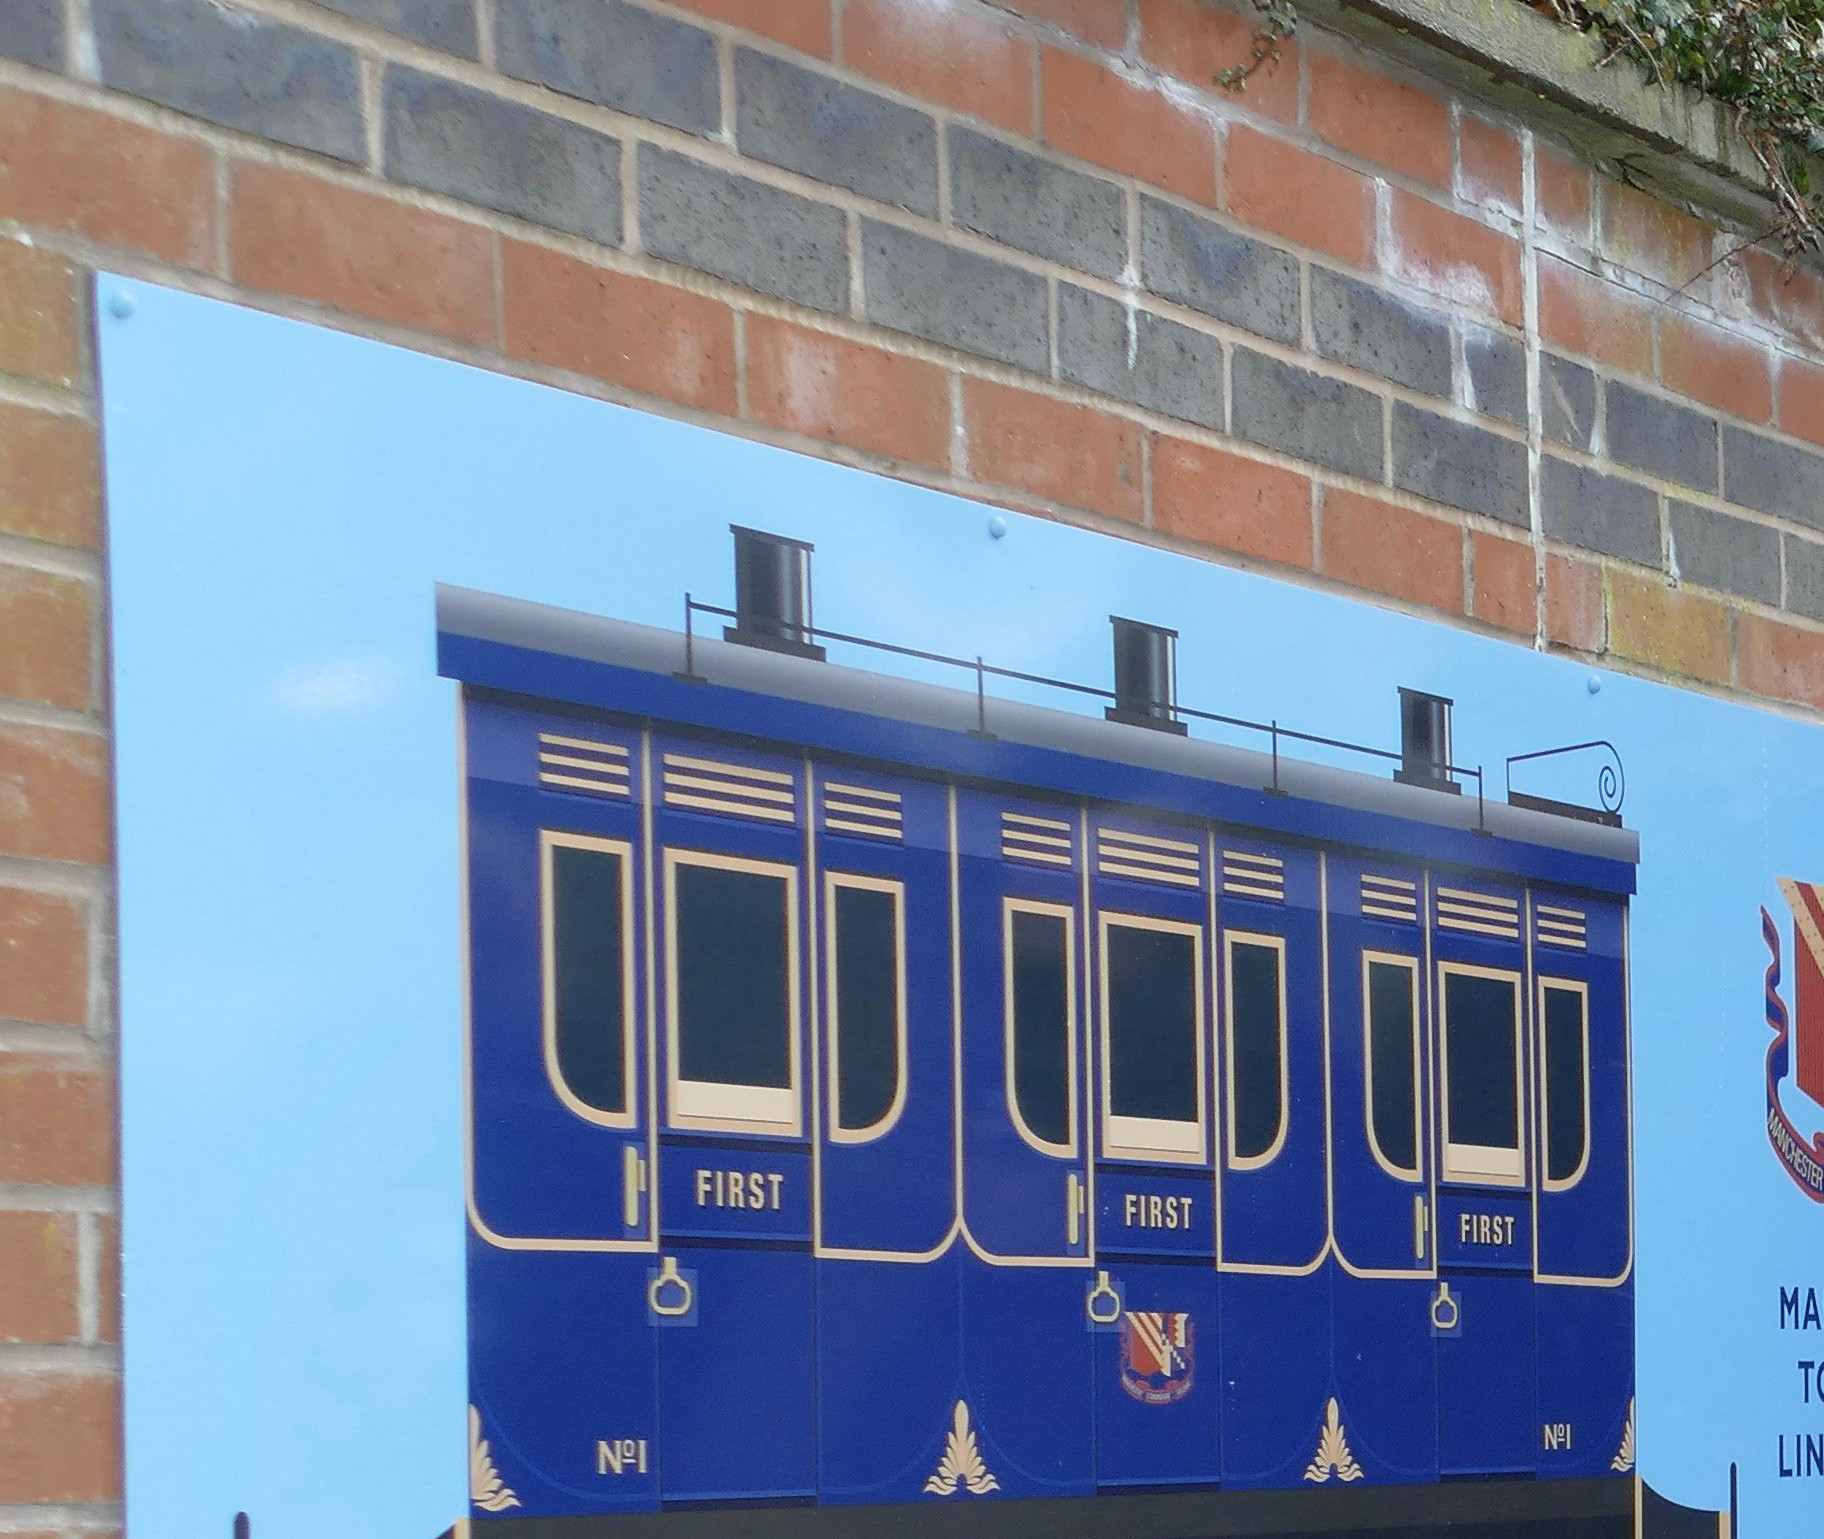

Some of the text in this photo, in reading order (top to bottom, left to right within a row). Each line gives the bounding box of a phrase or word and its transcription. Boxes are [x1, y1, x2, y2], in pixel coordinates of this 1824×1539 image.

[1768, 1108, 1823, 1191] MANCHESTER
[696, 1170, 784, 1209] FIRST
[1125, 1194, 1192, 1228] FIRST
[1461, 1214, 1514, 1244] FIRST
